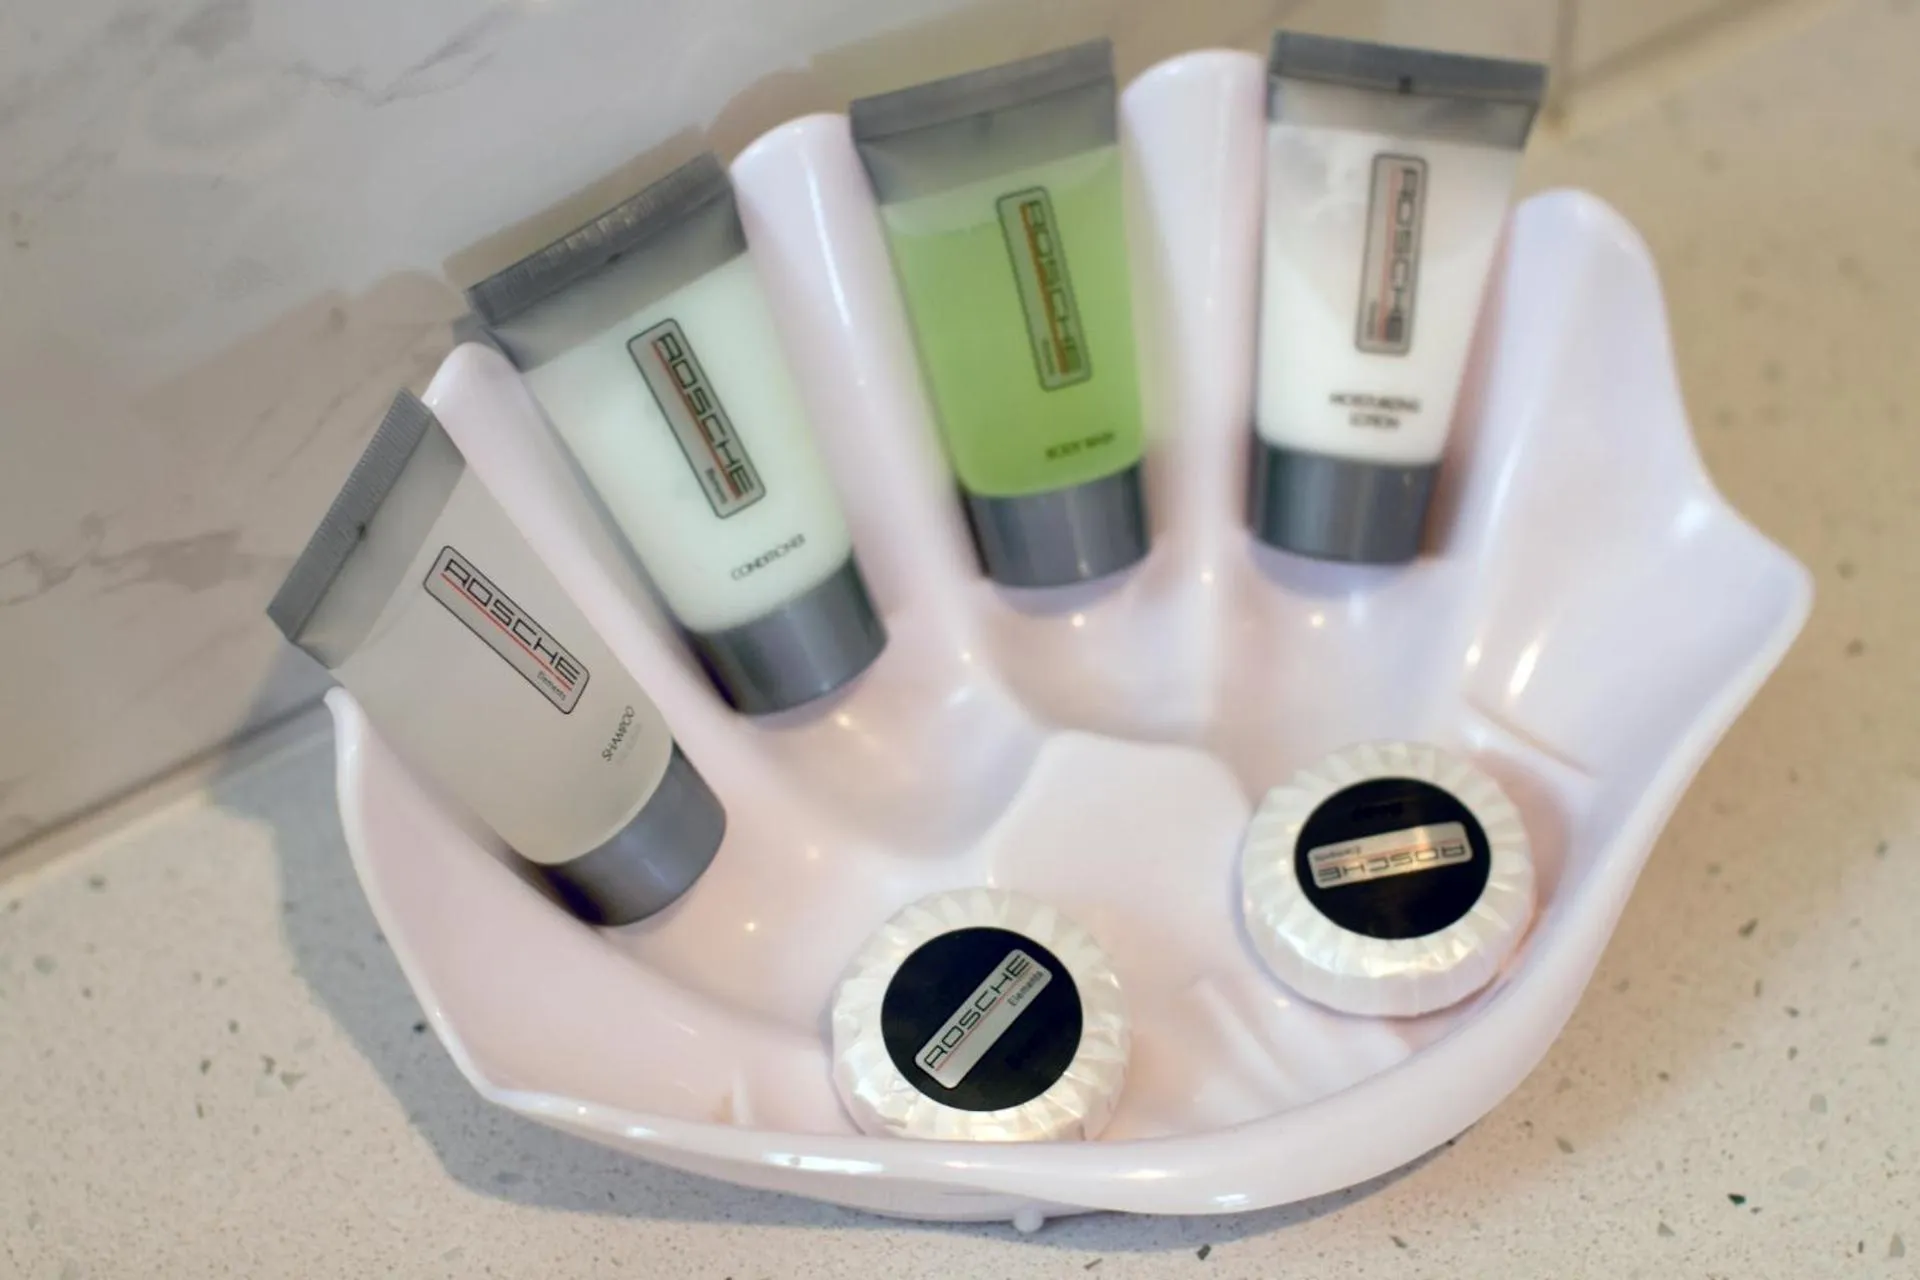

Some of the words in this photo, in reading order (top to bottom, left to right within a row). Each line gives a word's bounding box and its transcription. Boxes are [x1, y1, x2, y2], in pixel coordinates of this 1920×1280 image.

[1028, 199, 1082, 372] ROSCHE
[1387, 167, 1419, 343] ROSCHE
[656, 331, 755, 496] ROSCHE
[730, 532, 807, 582] CONDITIONER
[443, 558, 581, 686] ROSCHE
[536, 670, 567, 701] Elements
[601, 704, 636, 762] SHAMPOO
[1317, 843, 1466, 884] ROSCHE
[923, 953, 1031, 1069] ROSCHE
[1006, 970, 1044, 1007] Elements
